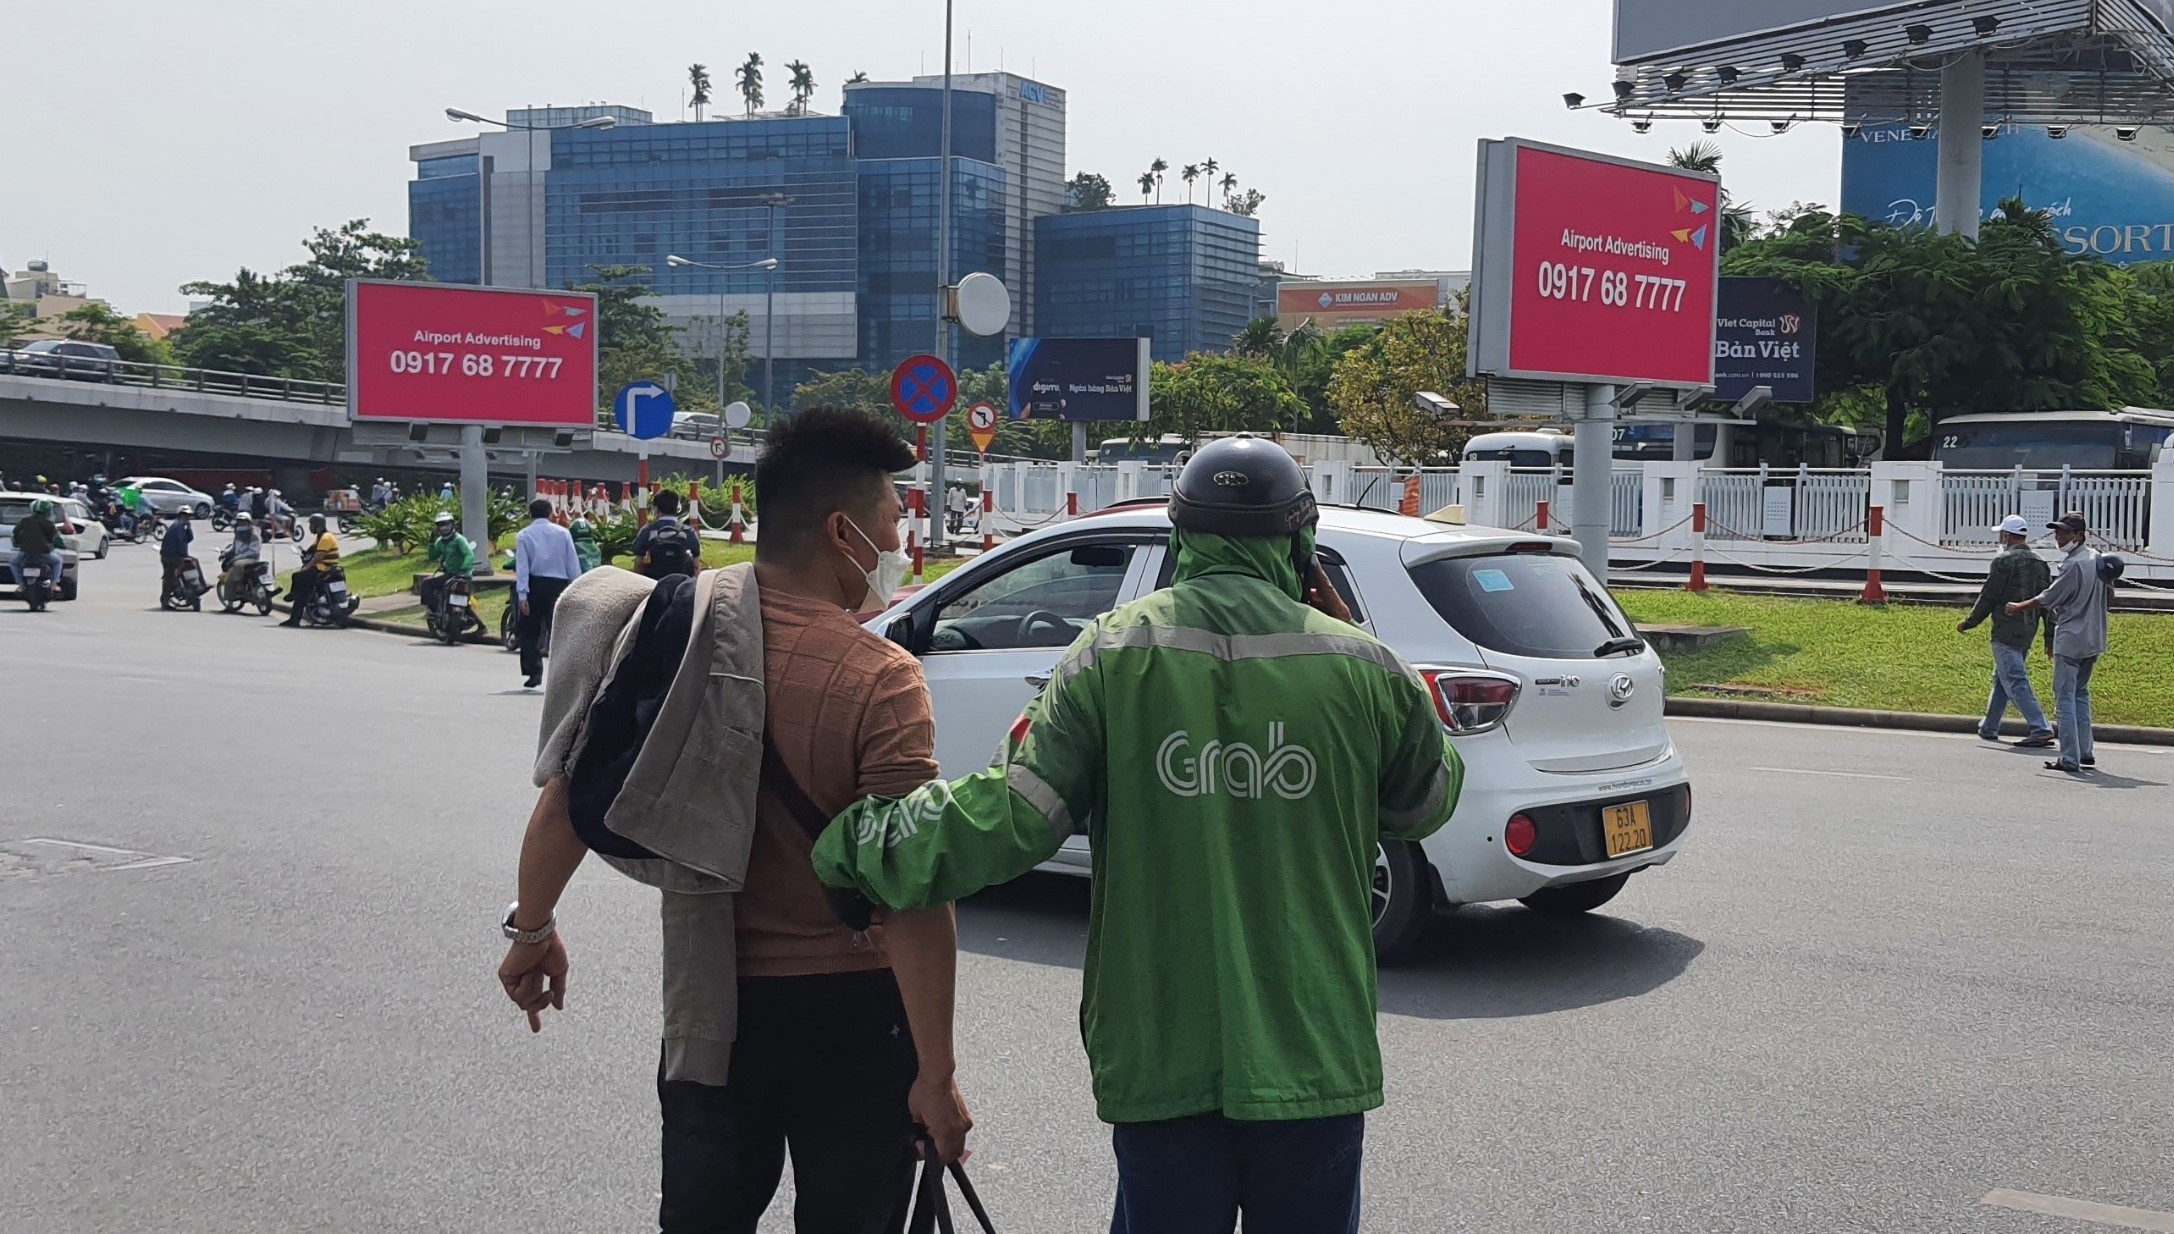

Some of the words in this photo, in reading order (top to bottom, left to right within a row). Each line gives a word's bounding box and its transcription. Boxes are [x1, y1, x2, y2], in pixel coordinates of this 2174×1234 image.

[1561, 228, 1603, 253] Airport
[1605, 235, 1669, 265] Advertising
[1335, 293, 1352, 302] KIM
[1353, 292, 1378, 302] NGAN
[1379, 291, 1398, 301] ADV
[1538, 261, 1595, 302] 0917
[1601, 270, 1627, 307] 68
[1634, 274, 1686, 312] 7777
[1717, 318, 1737, 328] Viet
[1739, 318, 1776, 329] Capital
[1755, 328, 1775, 336] Bank
[414, 330, 462, 345] Airport
[465, 332, 541, 350] Advertising
[1715, 340, 1756, 358] Bản
[1758, 341, 1800, 362] Việt
[390, 350, 455, 375] 0917
[462, 353, 494, 377] 68
[501, 355, 563, 379] 7777
[1943, 436, 1958, 449] 22
[1156, 721, 1318, 800] Grab
[1616, 806, 1636, 829] 63A
